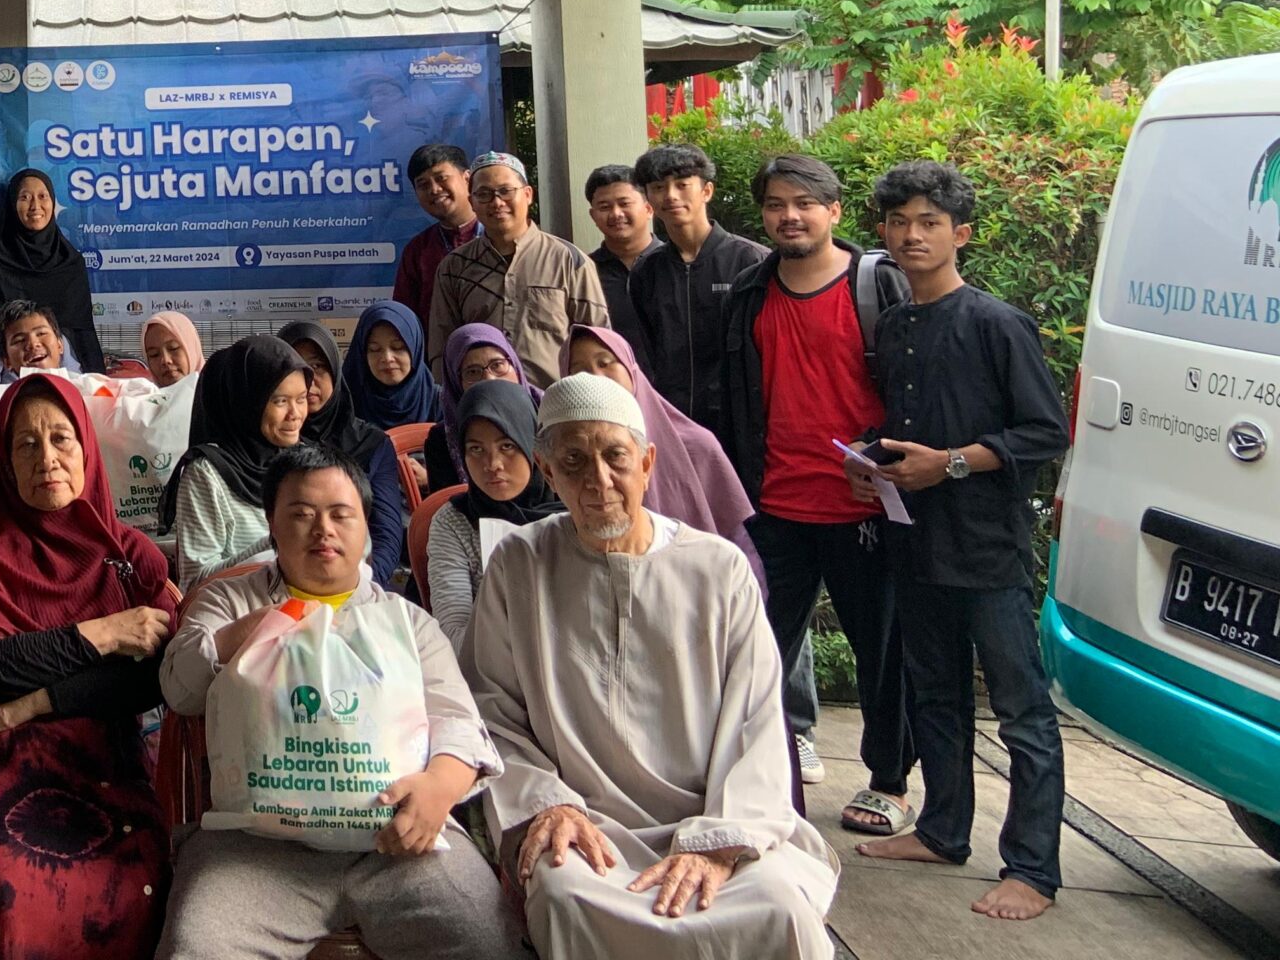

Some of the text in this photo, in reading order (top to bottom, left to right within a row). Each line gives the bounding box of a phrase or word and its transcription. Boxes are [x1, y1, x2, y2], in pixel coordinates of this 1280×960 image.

[159, 92, 215, 103] LAZ-MRBJ
[229, 90, 277, 101] REMISYA
[46, 121, 356, 163] Satu Harapan,
[70, 160, 401, 211] Sejuta Manfaat
[181, 219, 248, 231] Ramadhan
[251, 218, 290, 229] Penuh
[150, 254, 162, 263] 22
[163, 253, 193, 262] Maret
[195, 252, 220, 262] 2024
[266, 248, 379, 262] Yayasan Puspa Indah
[1127, 280, 1196, 315] MASJID
[1201, 288, 1258, 322] RAYA
[1139, 407, 1221, 443] @mrbjtangsel
[119, 496, 161, 507] Lebara
[1175, 564, 1193, 602] B
[1204, 576, 1263, 627] 9417
[284, 736, 372, 757] Bingkisan
[262, 754, 390, 774] Lebaran Untuk
[248, 772, 326, 790] Saudara
[253, 802, 308, 819] Lembaga
[310, 804, 336, 817] Amil
[339, 806, 373, 818] Zakat
[280, 818, 382, 831] Ramadhan 1445 H
